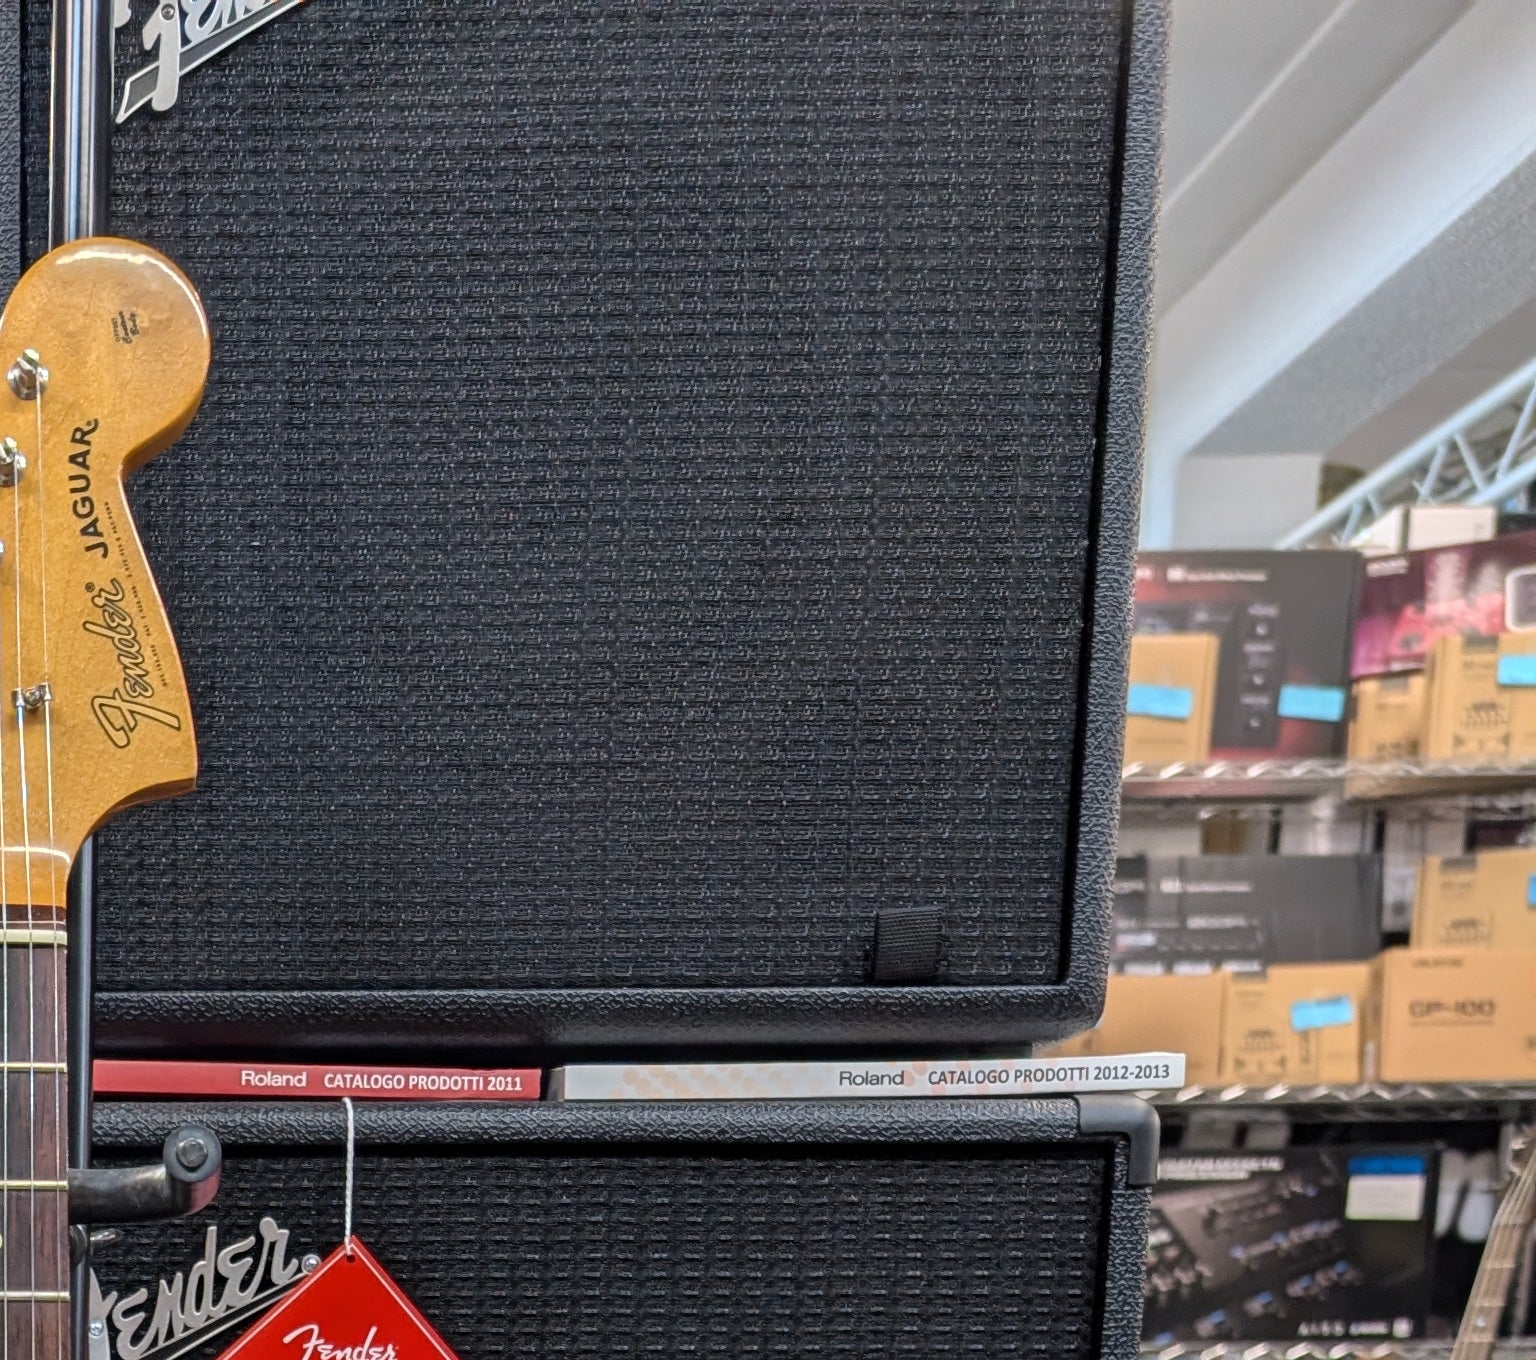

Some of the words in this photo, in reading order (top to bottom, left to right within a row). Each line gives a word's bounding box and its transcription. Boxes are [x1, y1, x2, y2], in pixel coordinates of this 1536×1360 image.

[68, 417, 109, 559] JAGUAR
[241, 1070, 307, 1087] Roland
[324, 1073, 405, 1090] CATALOGO
[409, 1075, 484, 1091] PRODOTTI
[487, 1076, 522, 1091] 2011
[839, 1070, 905, 1086] Roland
[928, 1068, 1010, 1086] CATALOGO
[1014, 1066, 1089, 1084] PRODOTTI
[1093, 1064, 1170, 1081] 2012-2013
